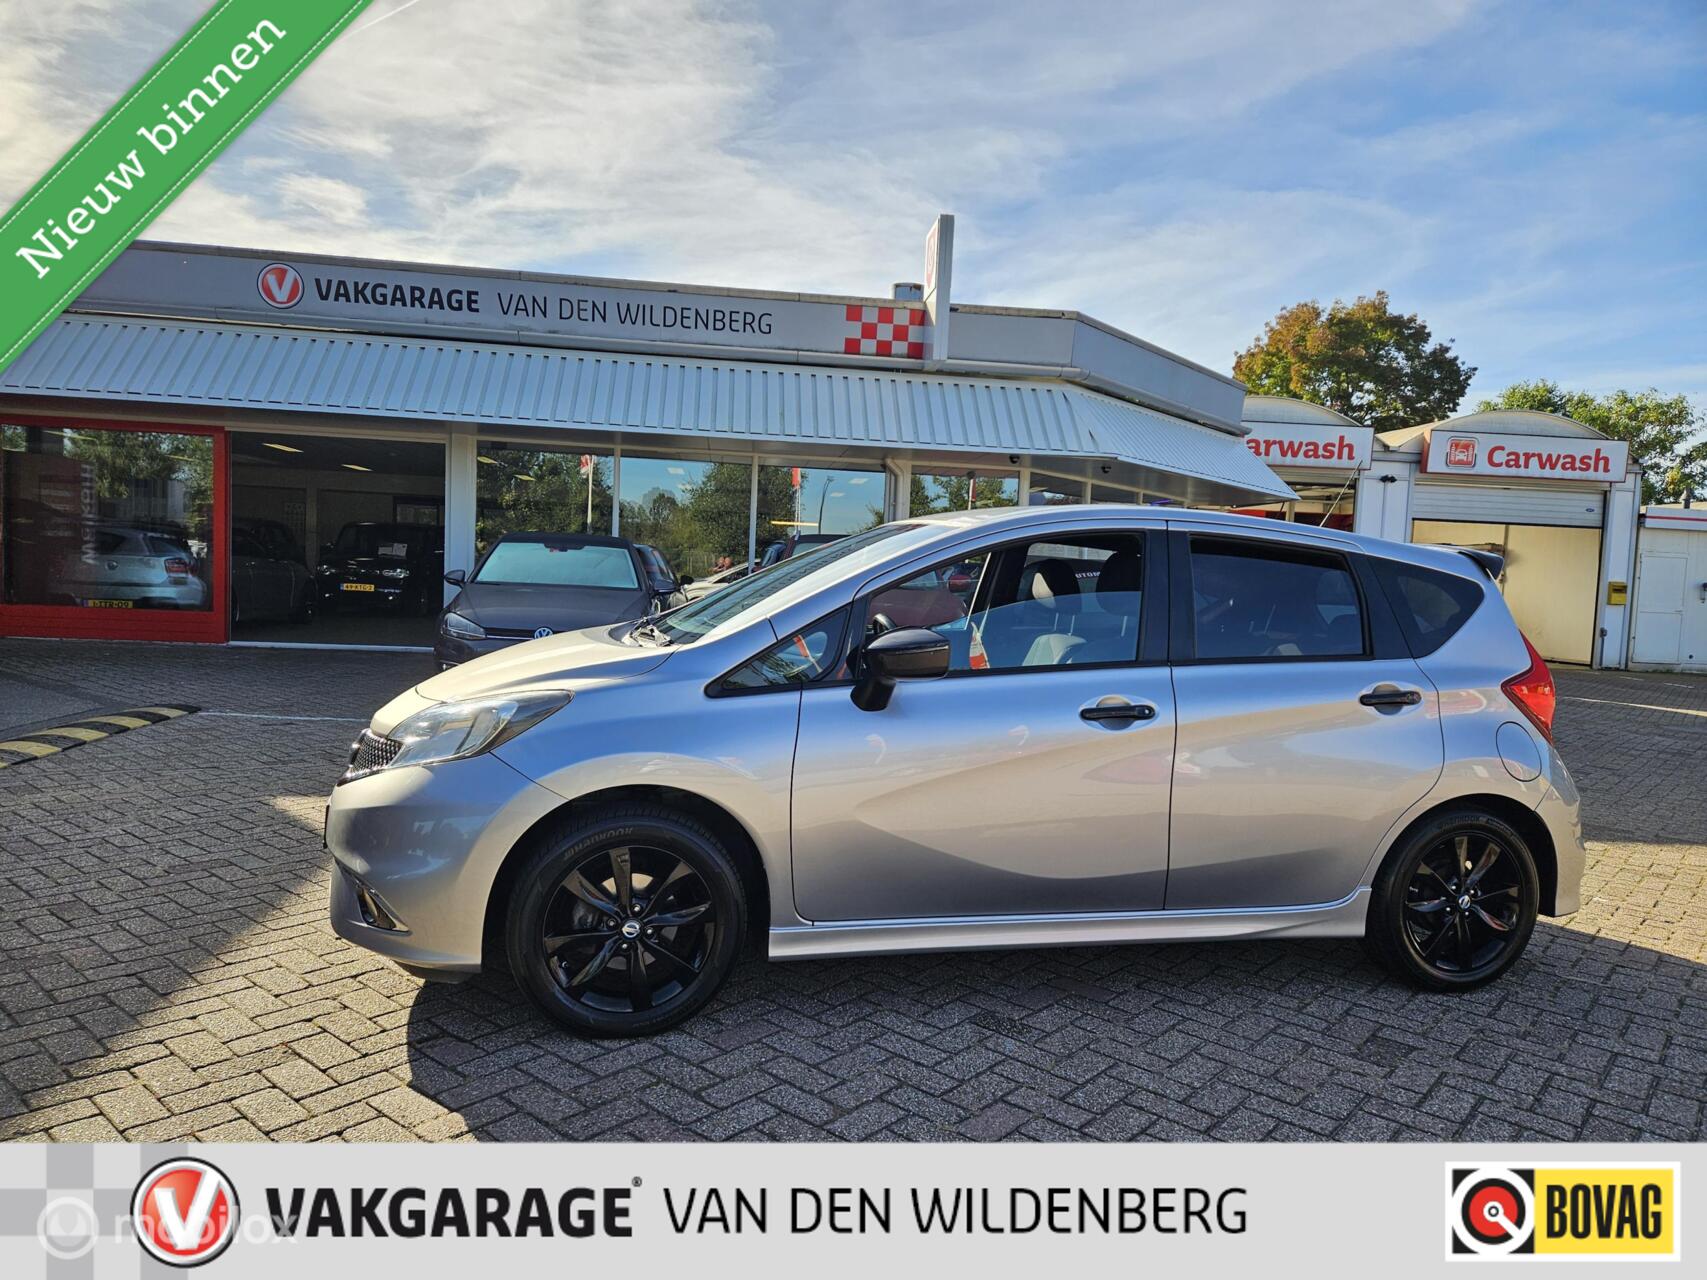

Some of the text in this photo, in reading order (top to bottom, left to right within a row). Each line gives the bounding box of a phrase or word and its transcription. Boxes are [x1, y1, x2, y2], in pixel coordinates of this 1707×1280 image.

[314, 277, 773, 335] VAKGARAGE VAN DEN WILDENBERG
[1246, 435, 1355, 460] arwash
[1487, 446, 1610, 473] Carwash
